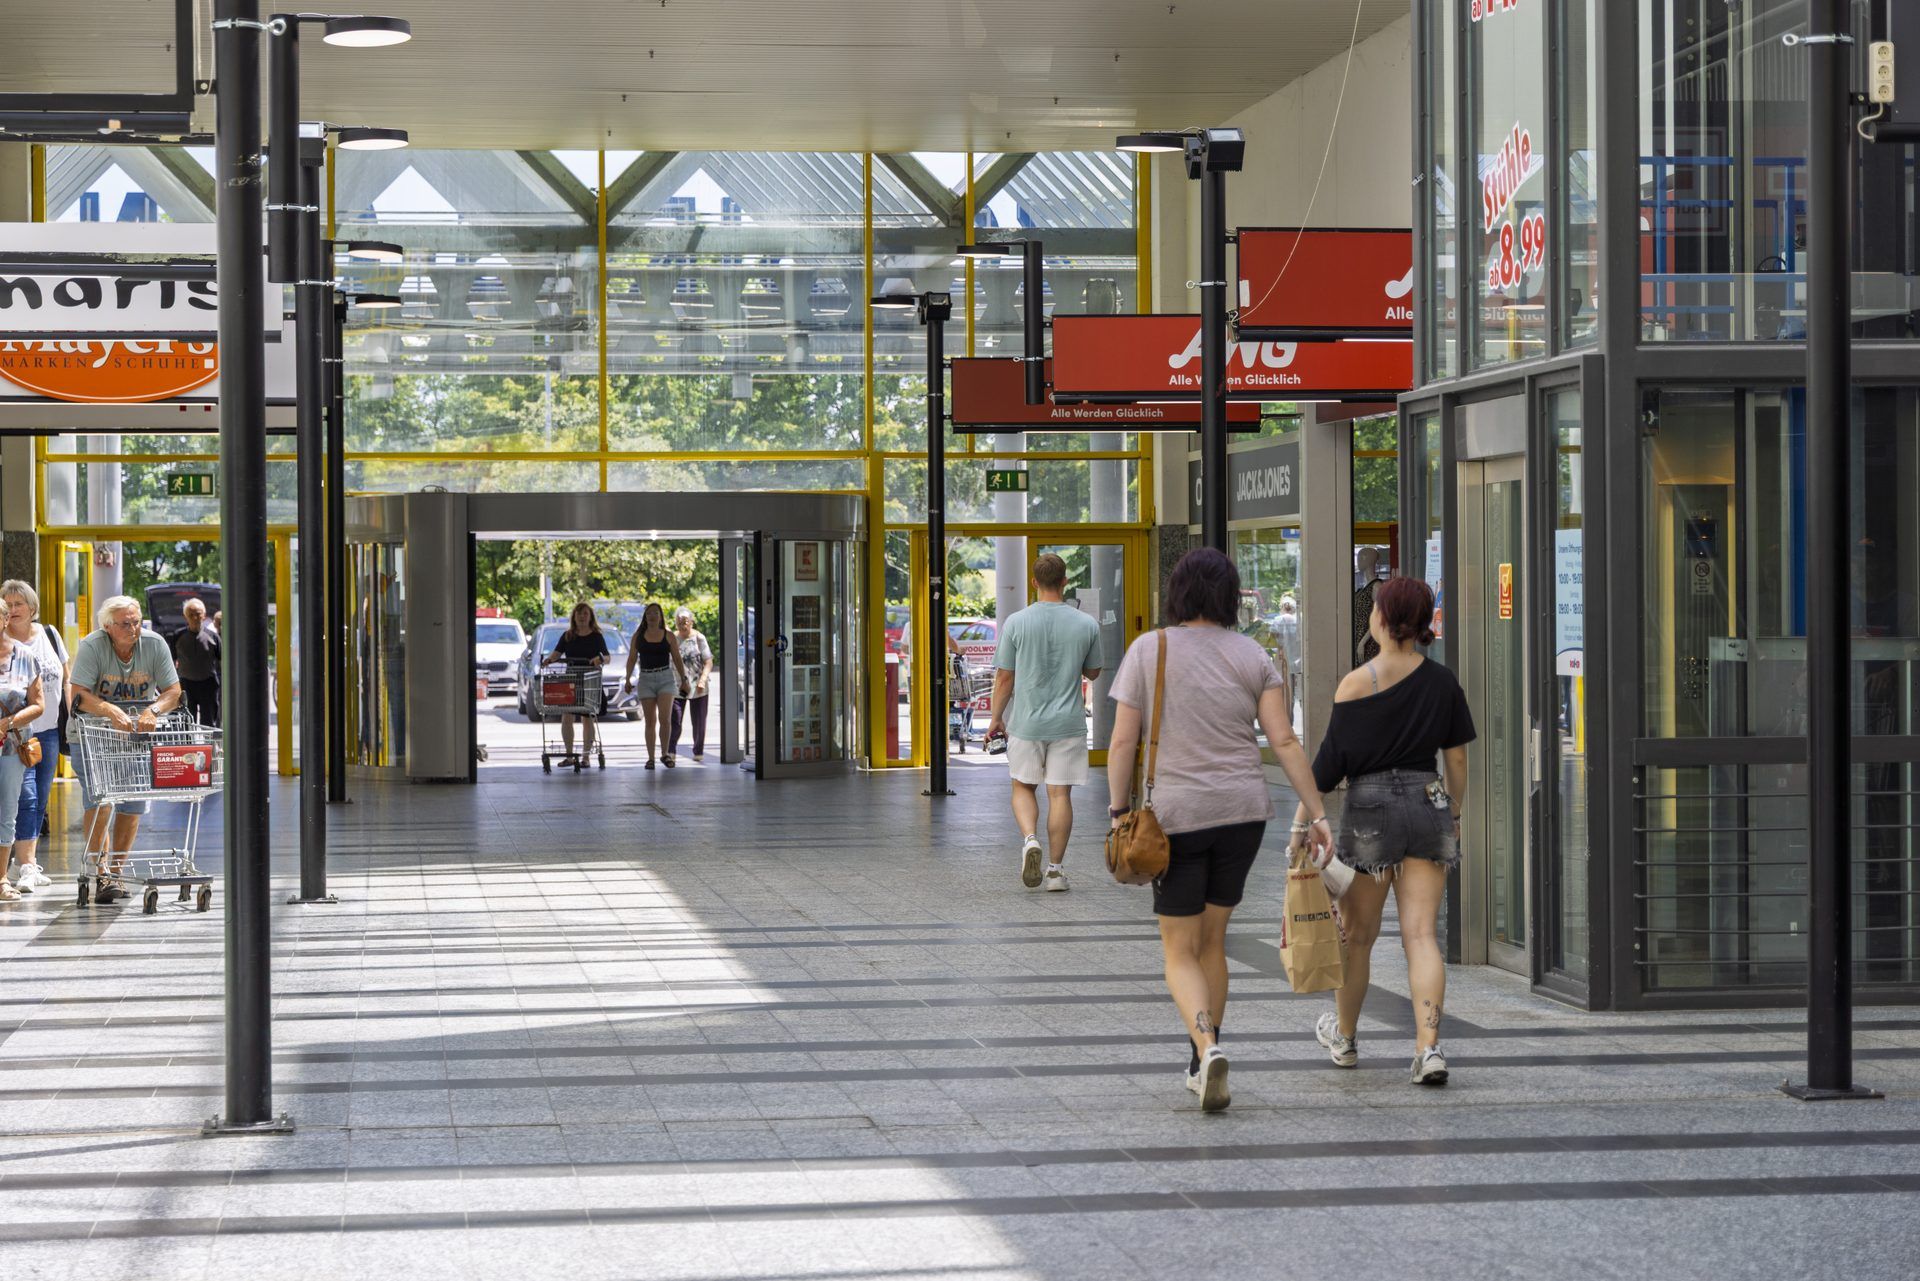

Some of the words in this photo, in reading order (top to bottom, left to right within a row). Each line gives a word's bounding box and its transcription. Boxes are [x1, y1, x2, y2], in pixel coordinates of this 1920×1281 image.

[1483, 121, 1531, 233] Stühle
[1489, 260, 1499, 289] ab
[1500, 214, 1544, 289] 8.99
[1385, 306, 1413, 320] Alle
[2, 357, 88, 368] MARKEN
[114, 357, 200, 369] SCHUHE
[1169, 375, 1192, 385] Alle
[1245, 374, 1301, 385] Glücklich
[1051, 408, 1071, 418] Alle
[1073, 408, 1113, 418] Werden
[1116, 407, 1163, 418] Glücklich
[1237, 464, 1290, 502] JACK&JONES
[100, 680, 149, 697] CAMP
